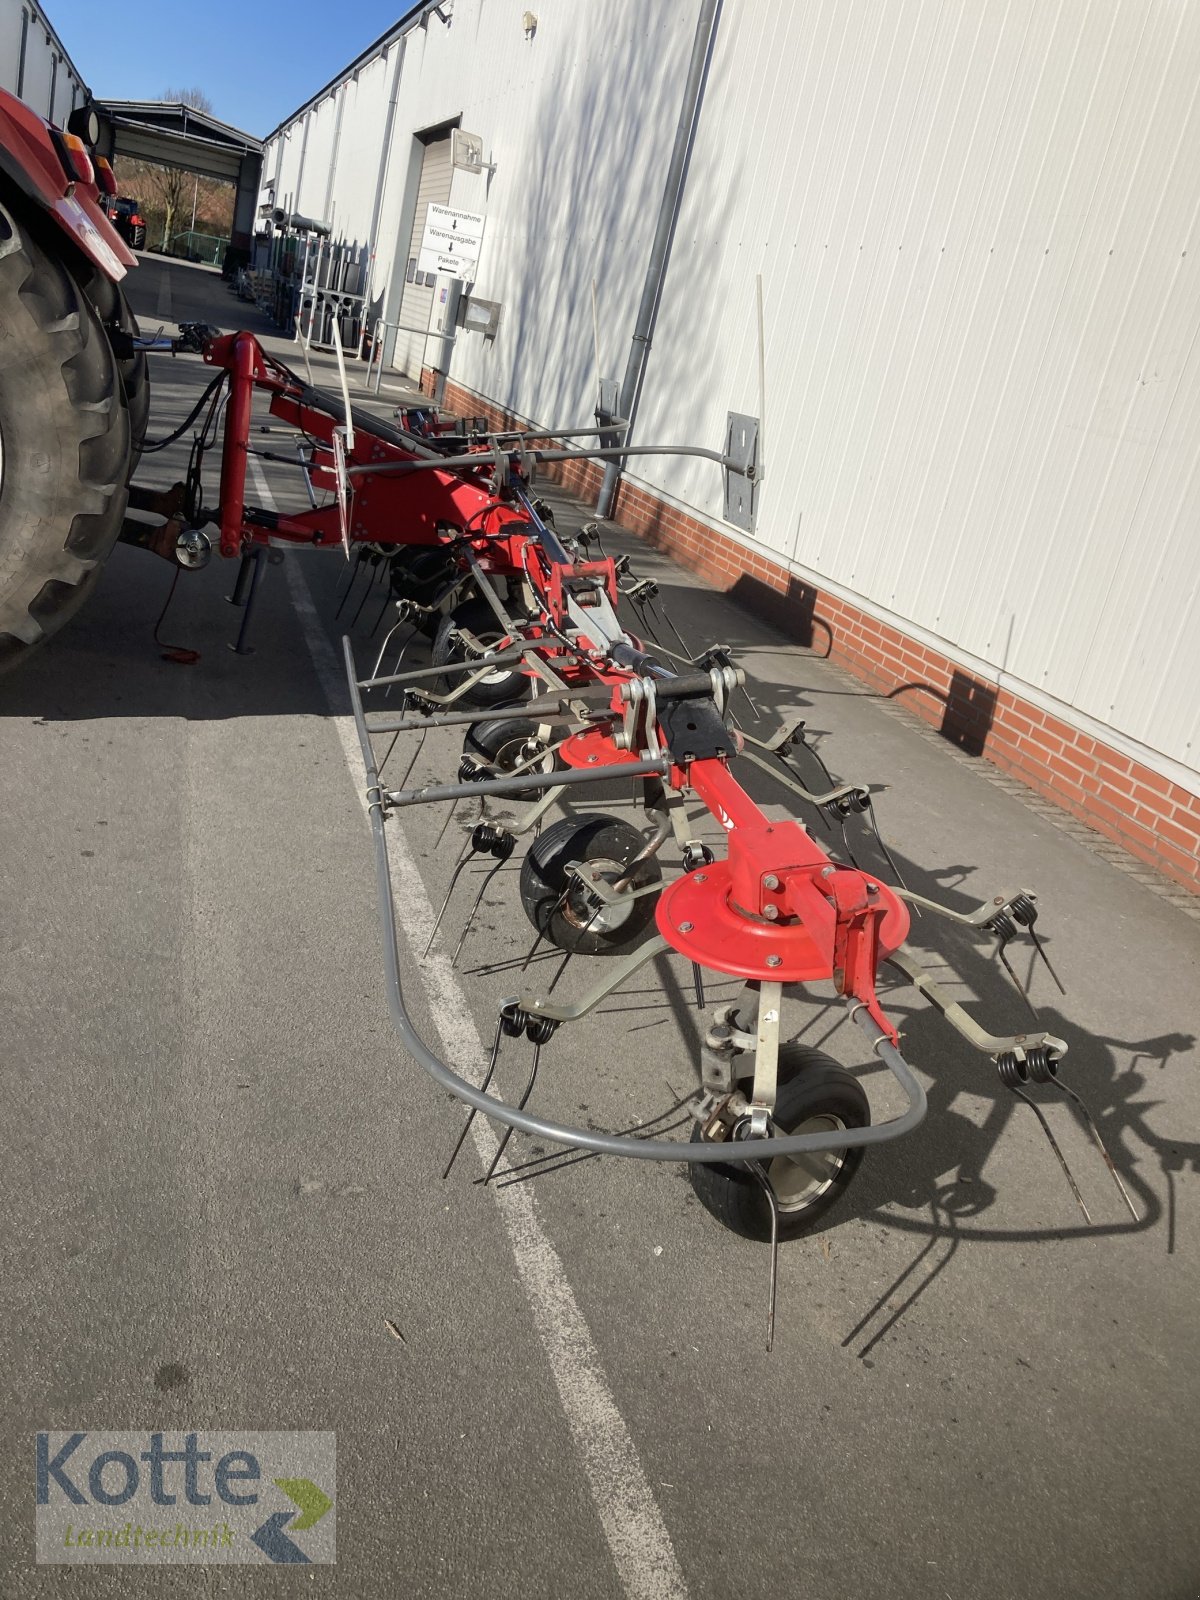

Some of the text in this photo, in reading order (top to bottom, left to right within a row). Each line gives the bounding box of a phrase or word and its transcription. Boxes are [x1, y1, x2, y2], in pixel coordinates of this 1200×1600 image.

[432, 206, 481, 223] Warenannahme
[429, 228, 476, 245] Warenausgabe
[437, 255, 460, 266] Pakete
